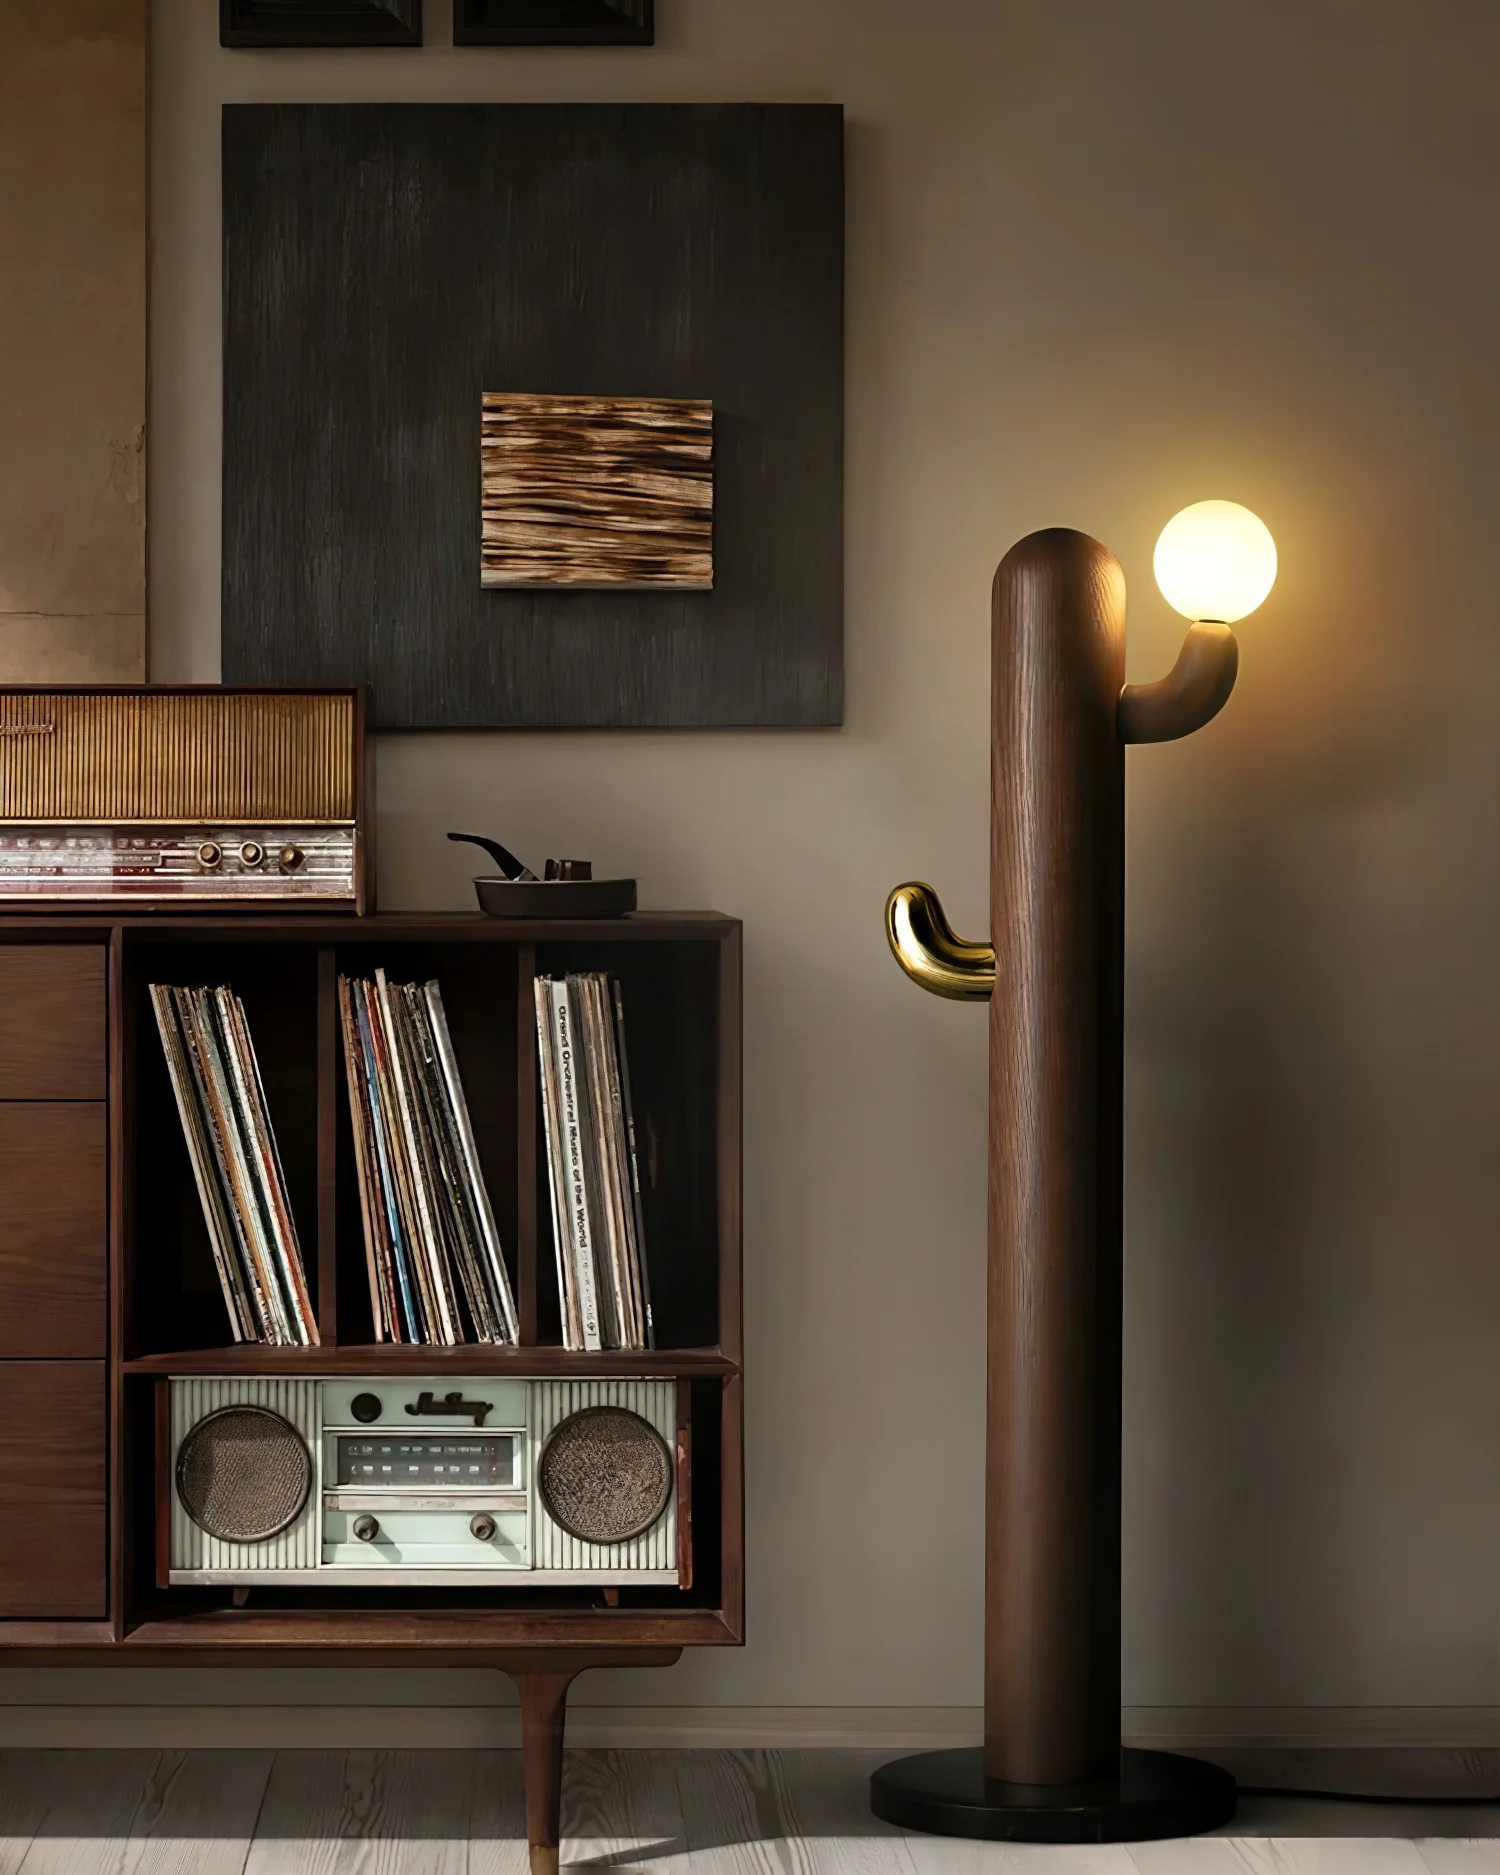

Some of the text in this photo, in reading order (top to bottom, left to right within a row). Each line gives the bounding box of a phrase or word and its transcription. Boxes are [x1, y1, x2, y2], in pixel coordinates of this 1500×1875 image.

[558, 1005, 569, 1048] Grand
[562, 1050, 575, 1122] Orchestral
[577, 1208, 587, 1248] World
